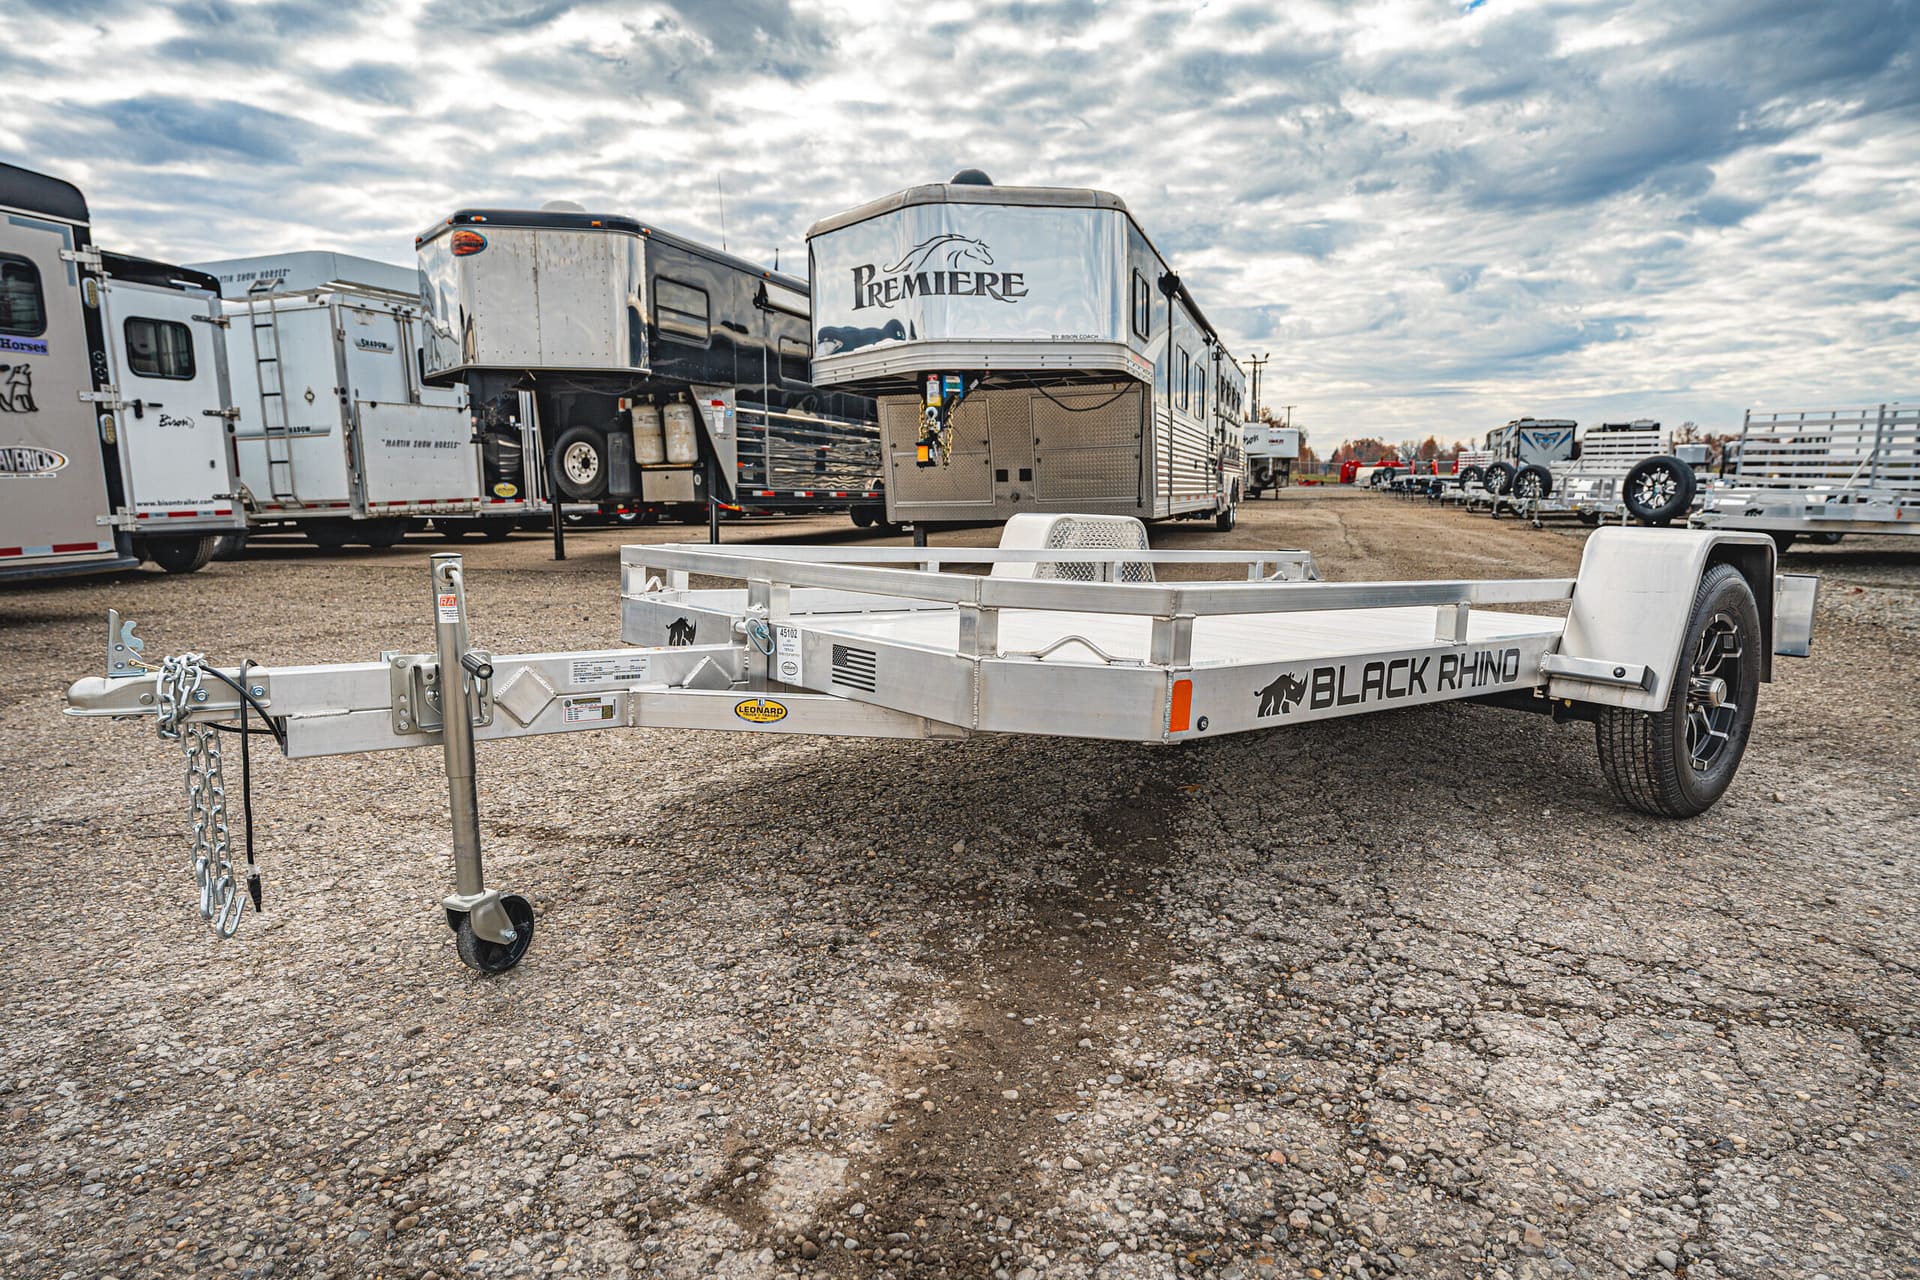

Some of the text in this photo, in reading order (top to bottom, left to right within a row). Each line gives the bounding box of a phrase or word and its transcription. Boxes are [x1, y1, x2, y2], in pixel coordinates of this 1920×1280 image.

[236, 272, 257, 283] SHOW
[851, 263, 1029, 311] PREMIERE
[0, 337, 48, 353] Horses
[413, 439, 432, 449] SHOW
[136, 499, 215, 507] www.bisontrailer.com
[780, 628, 798, 639] 45102
[1310, 648, 1521, 711] BLACK RHINO
[738, 706, 784, 715] LEONARD
